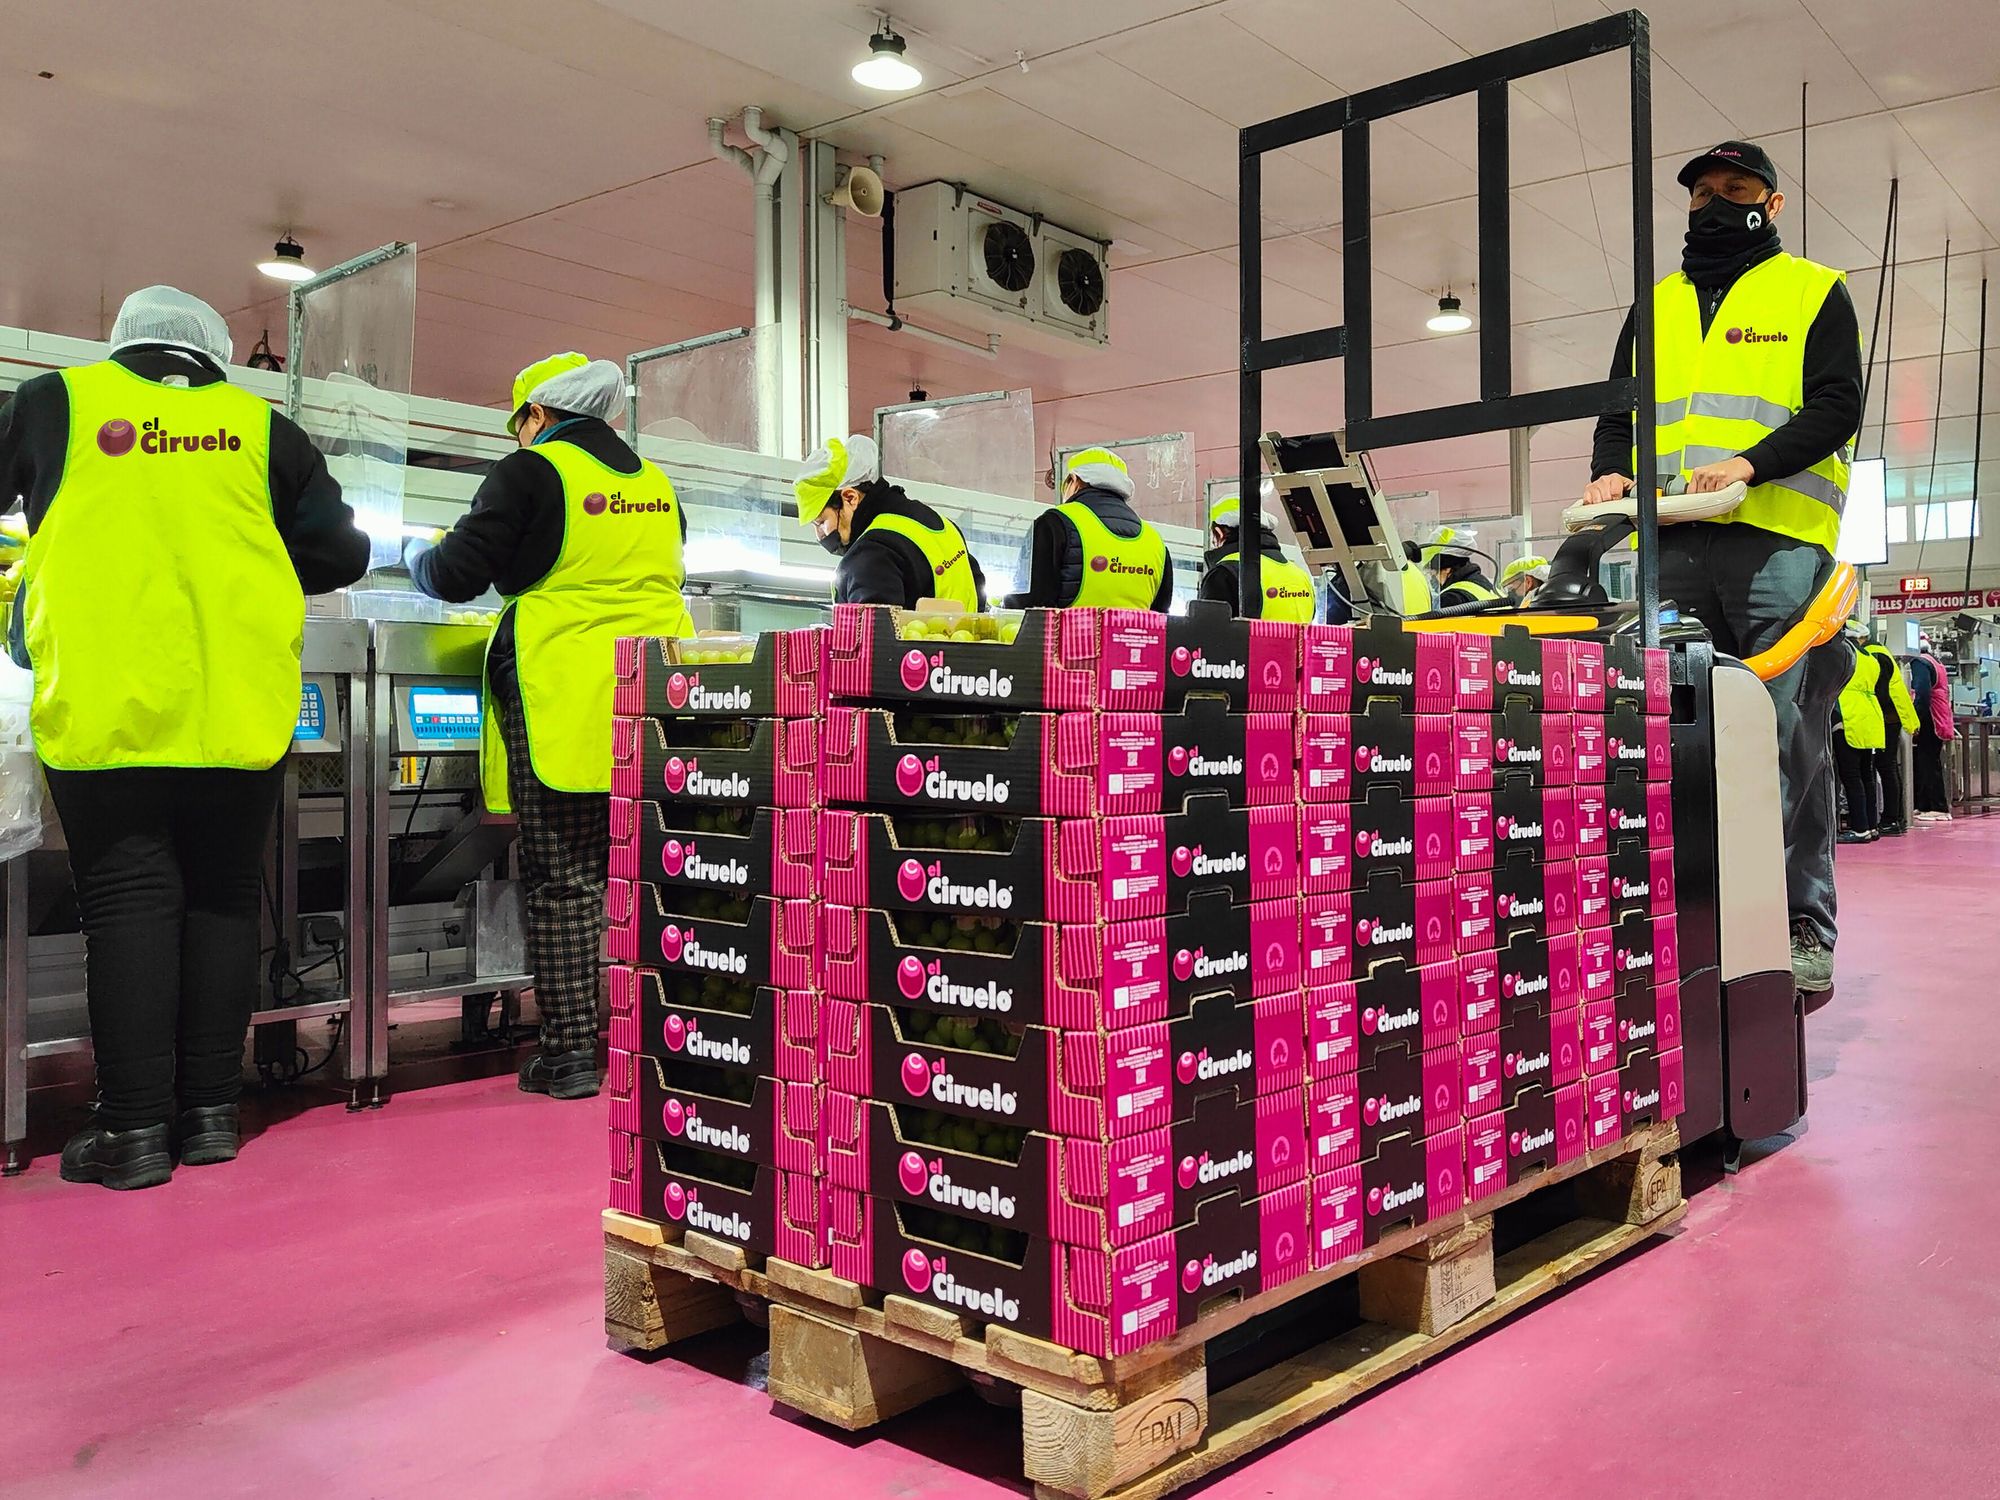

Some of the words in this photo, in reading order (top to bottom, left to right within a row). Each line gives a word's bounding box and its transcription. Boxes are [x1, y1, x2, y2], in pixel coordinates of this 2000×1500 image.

[1744, 331, 1788, 343] Ciruelo
[142, 417, 159, 432] el
[140, 429, 241, 455] Ciruelo
[610, 491, 621, 500] el
[608, 499, 670, 515] Ciruelo
[943, 548, 966, 571] Ciruelo
[1109, 562, 1154, 576] Ciruelo
[1905, 596, 1979, 609] EXPEDICIONES
[930, 651, 943, 667] el
[1192, 648, 1201, 659] el
[1192, 659, 1245, 680] Ciruelo
[1372, 660, 1379, 669] el
[689, 672, 699, 687] el
[930, 666, 1013, 698] Ciruelo
[1371, 667, 1414, 686] Ciruelo
[1508, 667, 1541, 686] Ciruelo
[1618, 672, 1646, 691] Ciruelo
[688, 684, 752, 710] Ciruelo
[1189, 746, 1198, 757] el
[1371, 747, 1379, 756] el
[1508, 745, 1542, 763] Ciruelo
[1618, 745, 1646, 760] Ciruelo
[687, 757, 697, 772] el
[926, 755, 939, 772] el
[1189, 755, 1243, 776] Ciruelo
[1370, 753, 1412, 773] Ciruelo
[687, 771, 751, 797] Ciruelo
[925, 770, 1010, 804] Ciruelo
[1509, 820, 1542, 840] Ciruelo
[1619, 811, 1647, 830] Ciruelo
[1371, 831, 1379, 840] el
[685, 842, 695, 856] el
[1192, 845, 1202, 855] el
[1371, 836, 1412, 858] Ciruelo
[684, 854, 748, 885] Ciruelo
[927, 861, 941, 877] el
[1193, 851, 1246, 875] Ciruelo
[927, 875, 1013, 910] Ciruelo
[1622, 880, 1650, 898] Ciruelo
[1509, 896, 1544, 918] Ciruelo
[1372, 917, 1380, 927] el
[684, 928, 694, 942] el
[1371, 921, 1413, 945] Ciruelo
[684, 941, 747, 974] Ciruelo
[1194, 947, 1203, 959] el
[1626, 950, 1653, 970] Ciruelo
[927, 959, 940, 976] el
[1194, 951, 1248, 978] Ciruelo
[927, 974, 1013, 1012] Ciruelo
[1514, 974, 1548, 995] Ciruelo
[1378, 1005, 1385, 1015] el
[686, 1018, 696, 1032] el
[1378, 1007, 1420, 1033] Ciruelo
[1628, 1019, 1656, 1040] Ciruelo
[686, 1028, 752, 1065] Ciruelo
[1198, 1047, 1207, 1060] el
[931, 1057, 945, 1075] el
[1198, 1049, 1252, 1080] Ciruelo
[1516, 1052, 1550, 1076] Ciruelo
[932, 1072, 1017, 1115] Ciruelo
[1380, 1093, 1387, 1105] el
[1632, 1088, 1659, 1111] Ciruelo
[686, 1103, 696, 1118] el
[1379, 1094, 1421, 1123] Ciruelo
[686, 1115, 750, 1154] Ciruelo
[1521, 1127, 1555, 1152] Ciruelo
[929, 1158, 942, 1175] el
[1198, 1149, 1253, 1184] Ciruelo
[1199, 1151, 1208, 1164] el
[687, 1187, 697, 1202] el
[929, 1174, 1016, 1220] Ciruelo
[1383, 1182, 1391, 1194] el
[1383, 1181, 1425, 1211] Ciruelo
[686, 1199, 752, 1241] Ciruelo
[932, 1256, 946, 1274] el
[1202, 1249, 1257, 1287] Ciruelo
[1203, 1254, 1213, 1268] el
[932, 1271, 1020, 1322] Ciruelo
